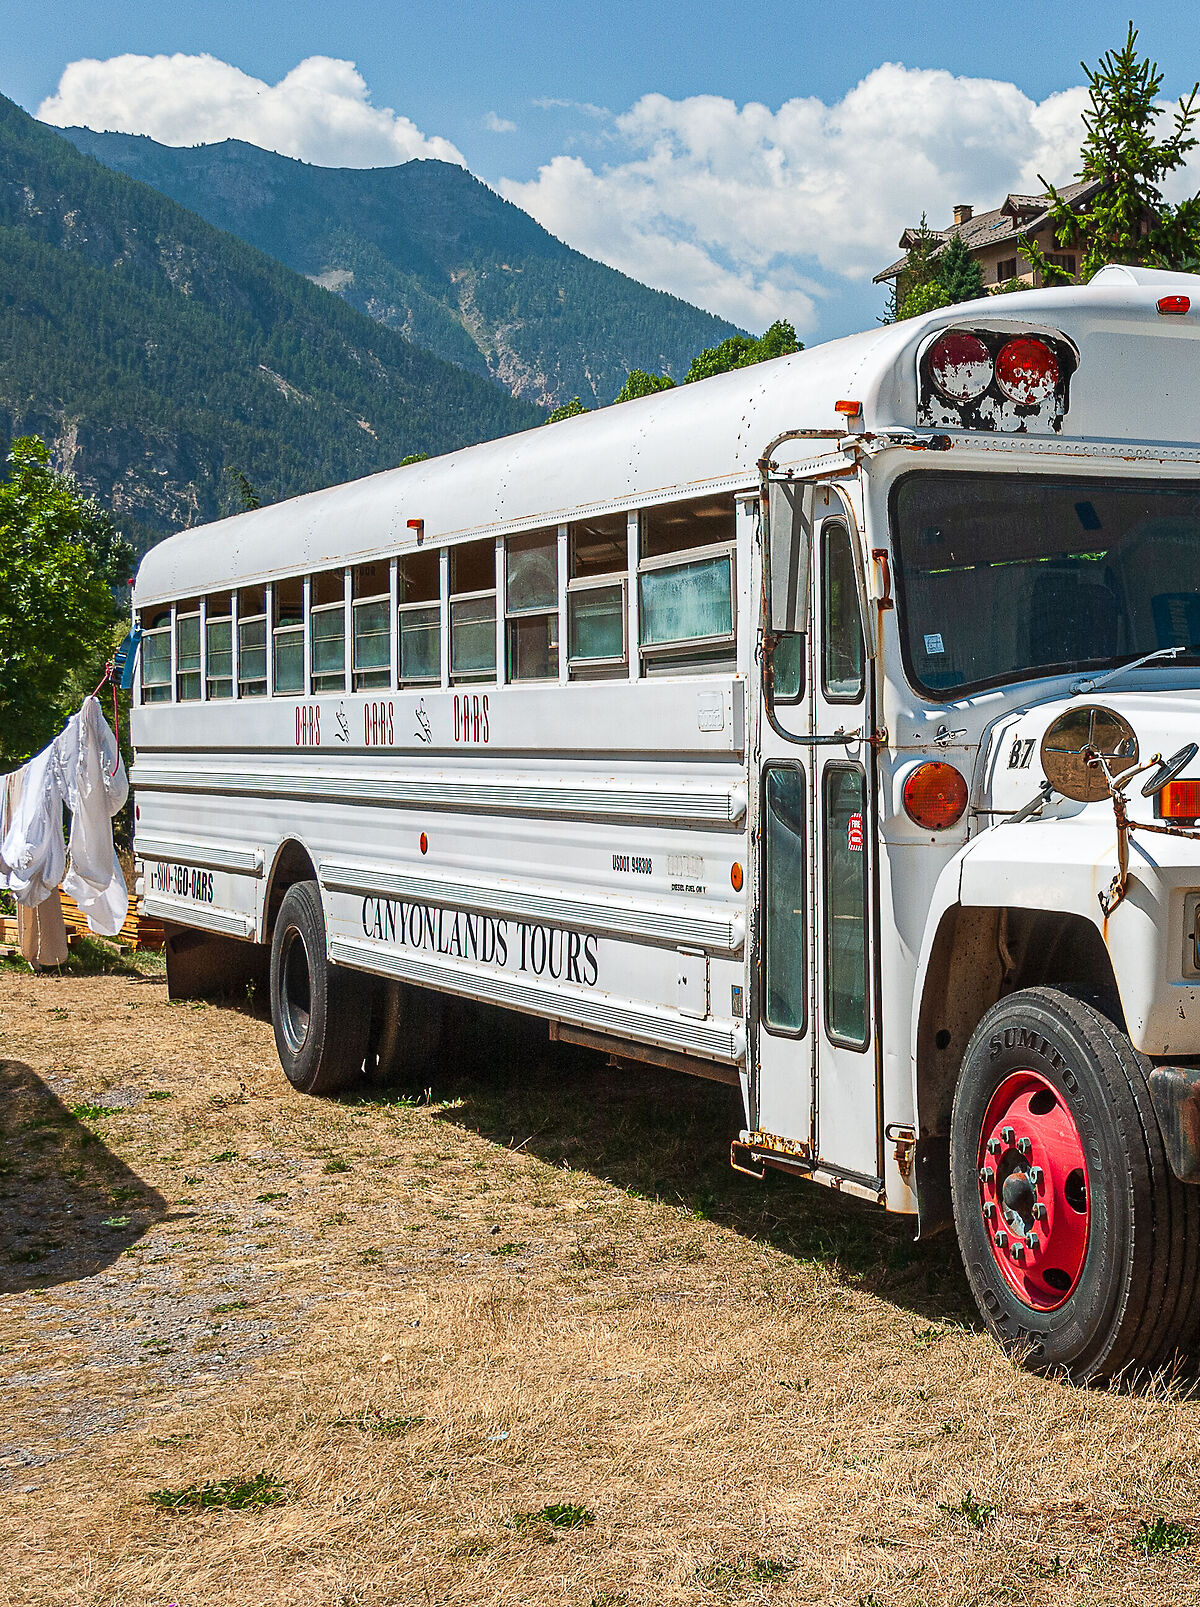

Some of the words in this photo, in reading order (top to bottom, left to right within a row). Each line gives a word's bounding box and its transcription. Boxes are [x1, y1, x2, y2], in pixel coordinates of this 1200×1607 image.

[362, 894, 508, 967] CANYONLANDS
[516, 923, 599, 987] TOURS
[989, 1026, 1103, 1171] SUMITOMO
